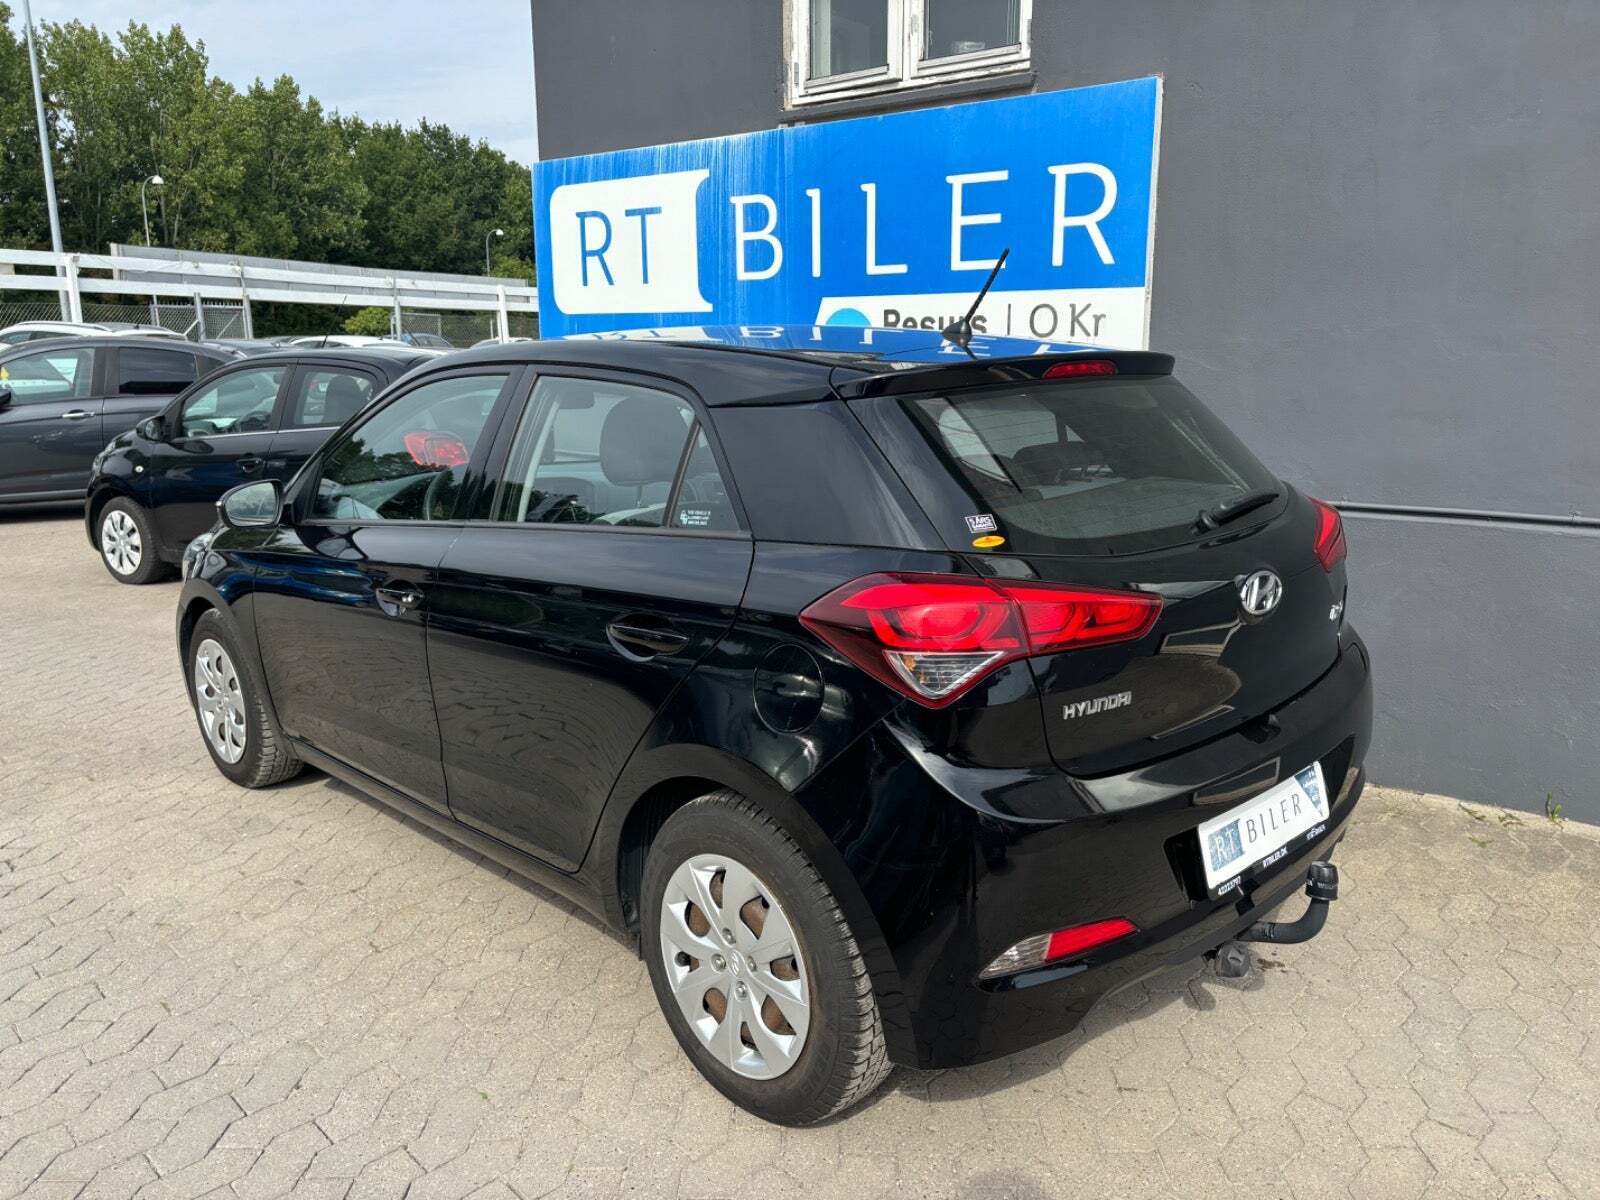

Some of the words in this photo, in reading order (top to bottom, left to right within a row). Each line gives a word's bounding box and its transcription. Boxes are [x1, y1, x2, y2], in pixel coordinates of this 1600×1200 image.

[575, 206, 662, 286] RT
[729, 162, 1118, 280] BILER
[883, 308, 987, 333] Ress
[1063, 691, 1132, 720] HYUNDAI
[1246, 793, 1302, 843] BILER
